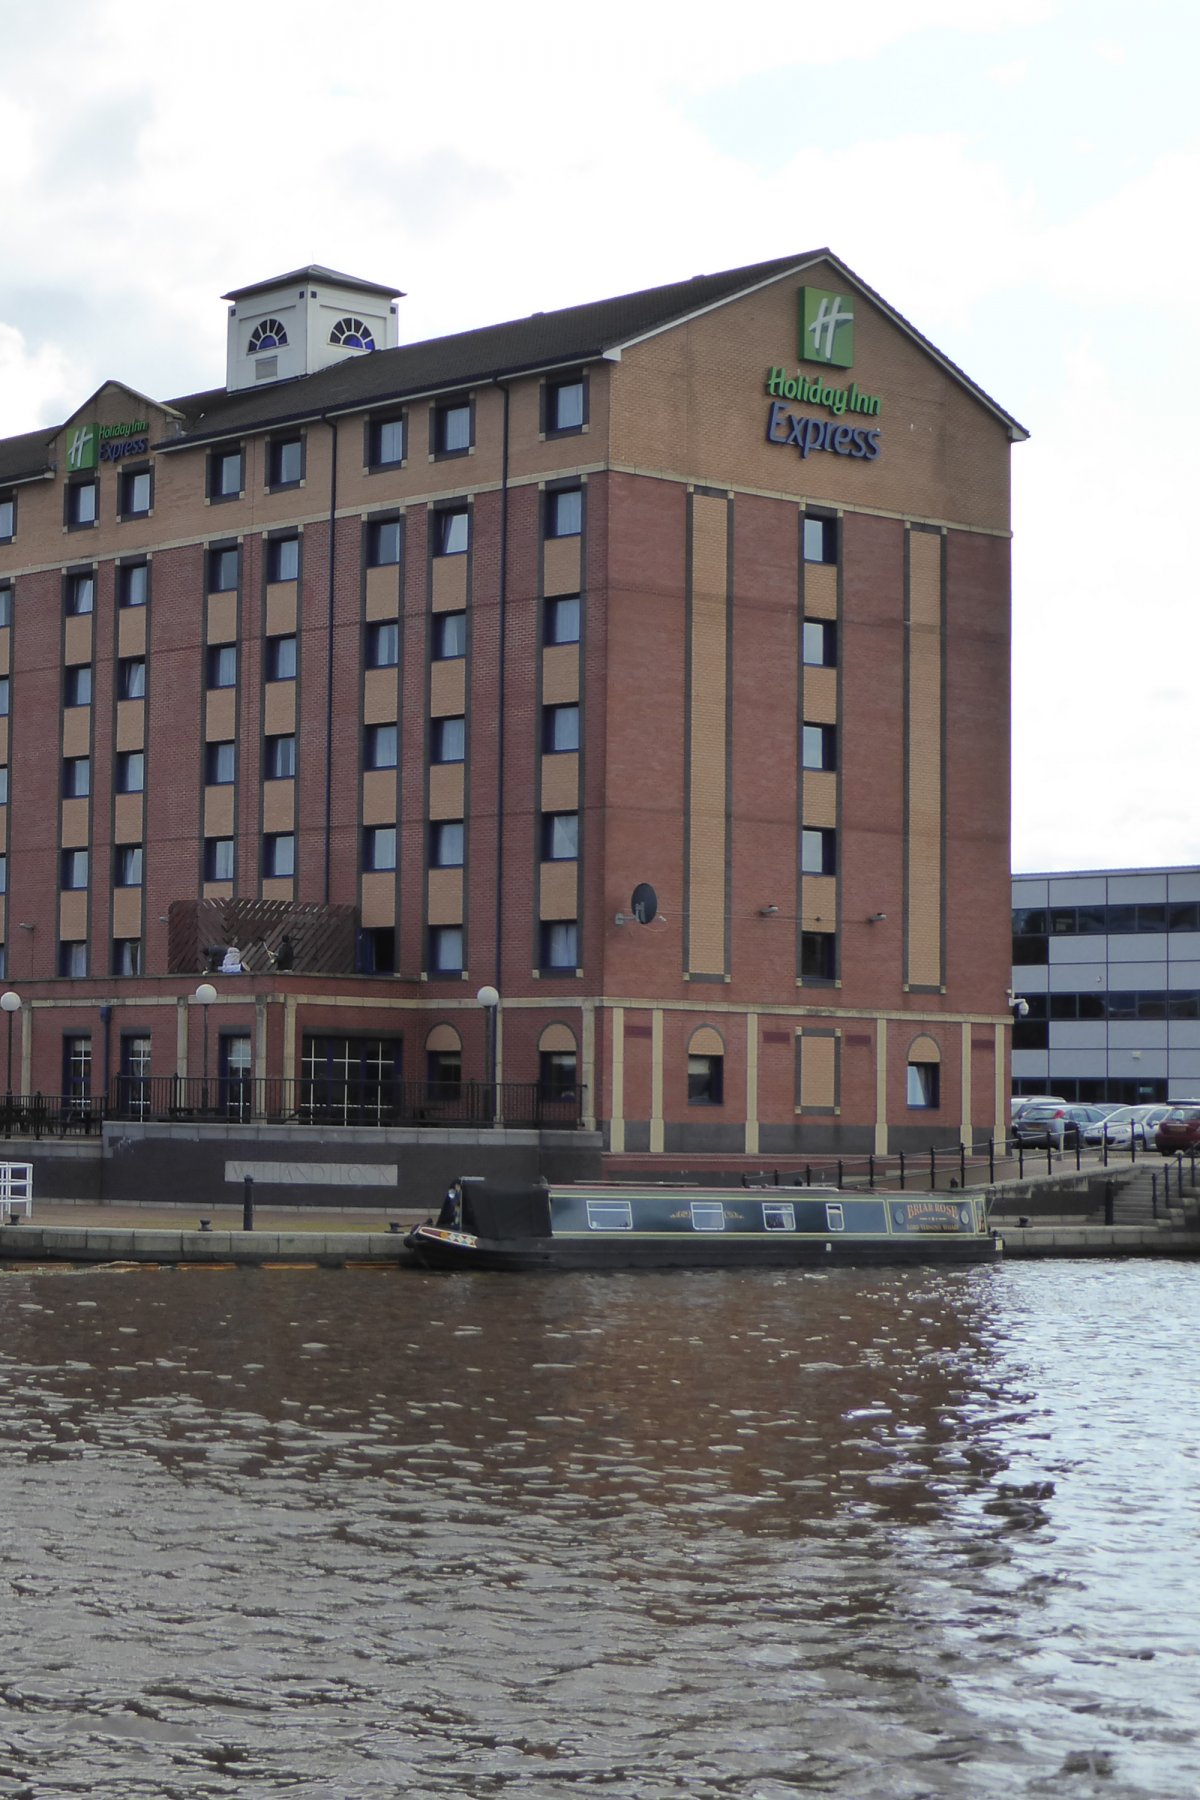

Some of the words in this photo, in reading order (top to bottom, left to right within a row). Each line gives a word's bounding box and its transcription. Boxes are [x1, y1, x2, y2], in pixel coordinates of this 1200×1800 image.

[768, 366, 848, 416] Holiday
[850, 383, 881, 415] Inn
[99, 421, 131, 440] Holiday
[131, 419, 146, 433] Inn
[767, 401, 881, 459] Express
[99, 439, 146, 463] Express
[907, 1203, 933, 1219] BRIAR
[934, 1203, 959, 1219] ROSE
